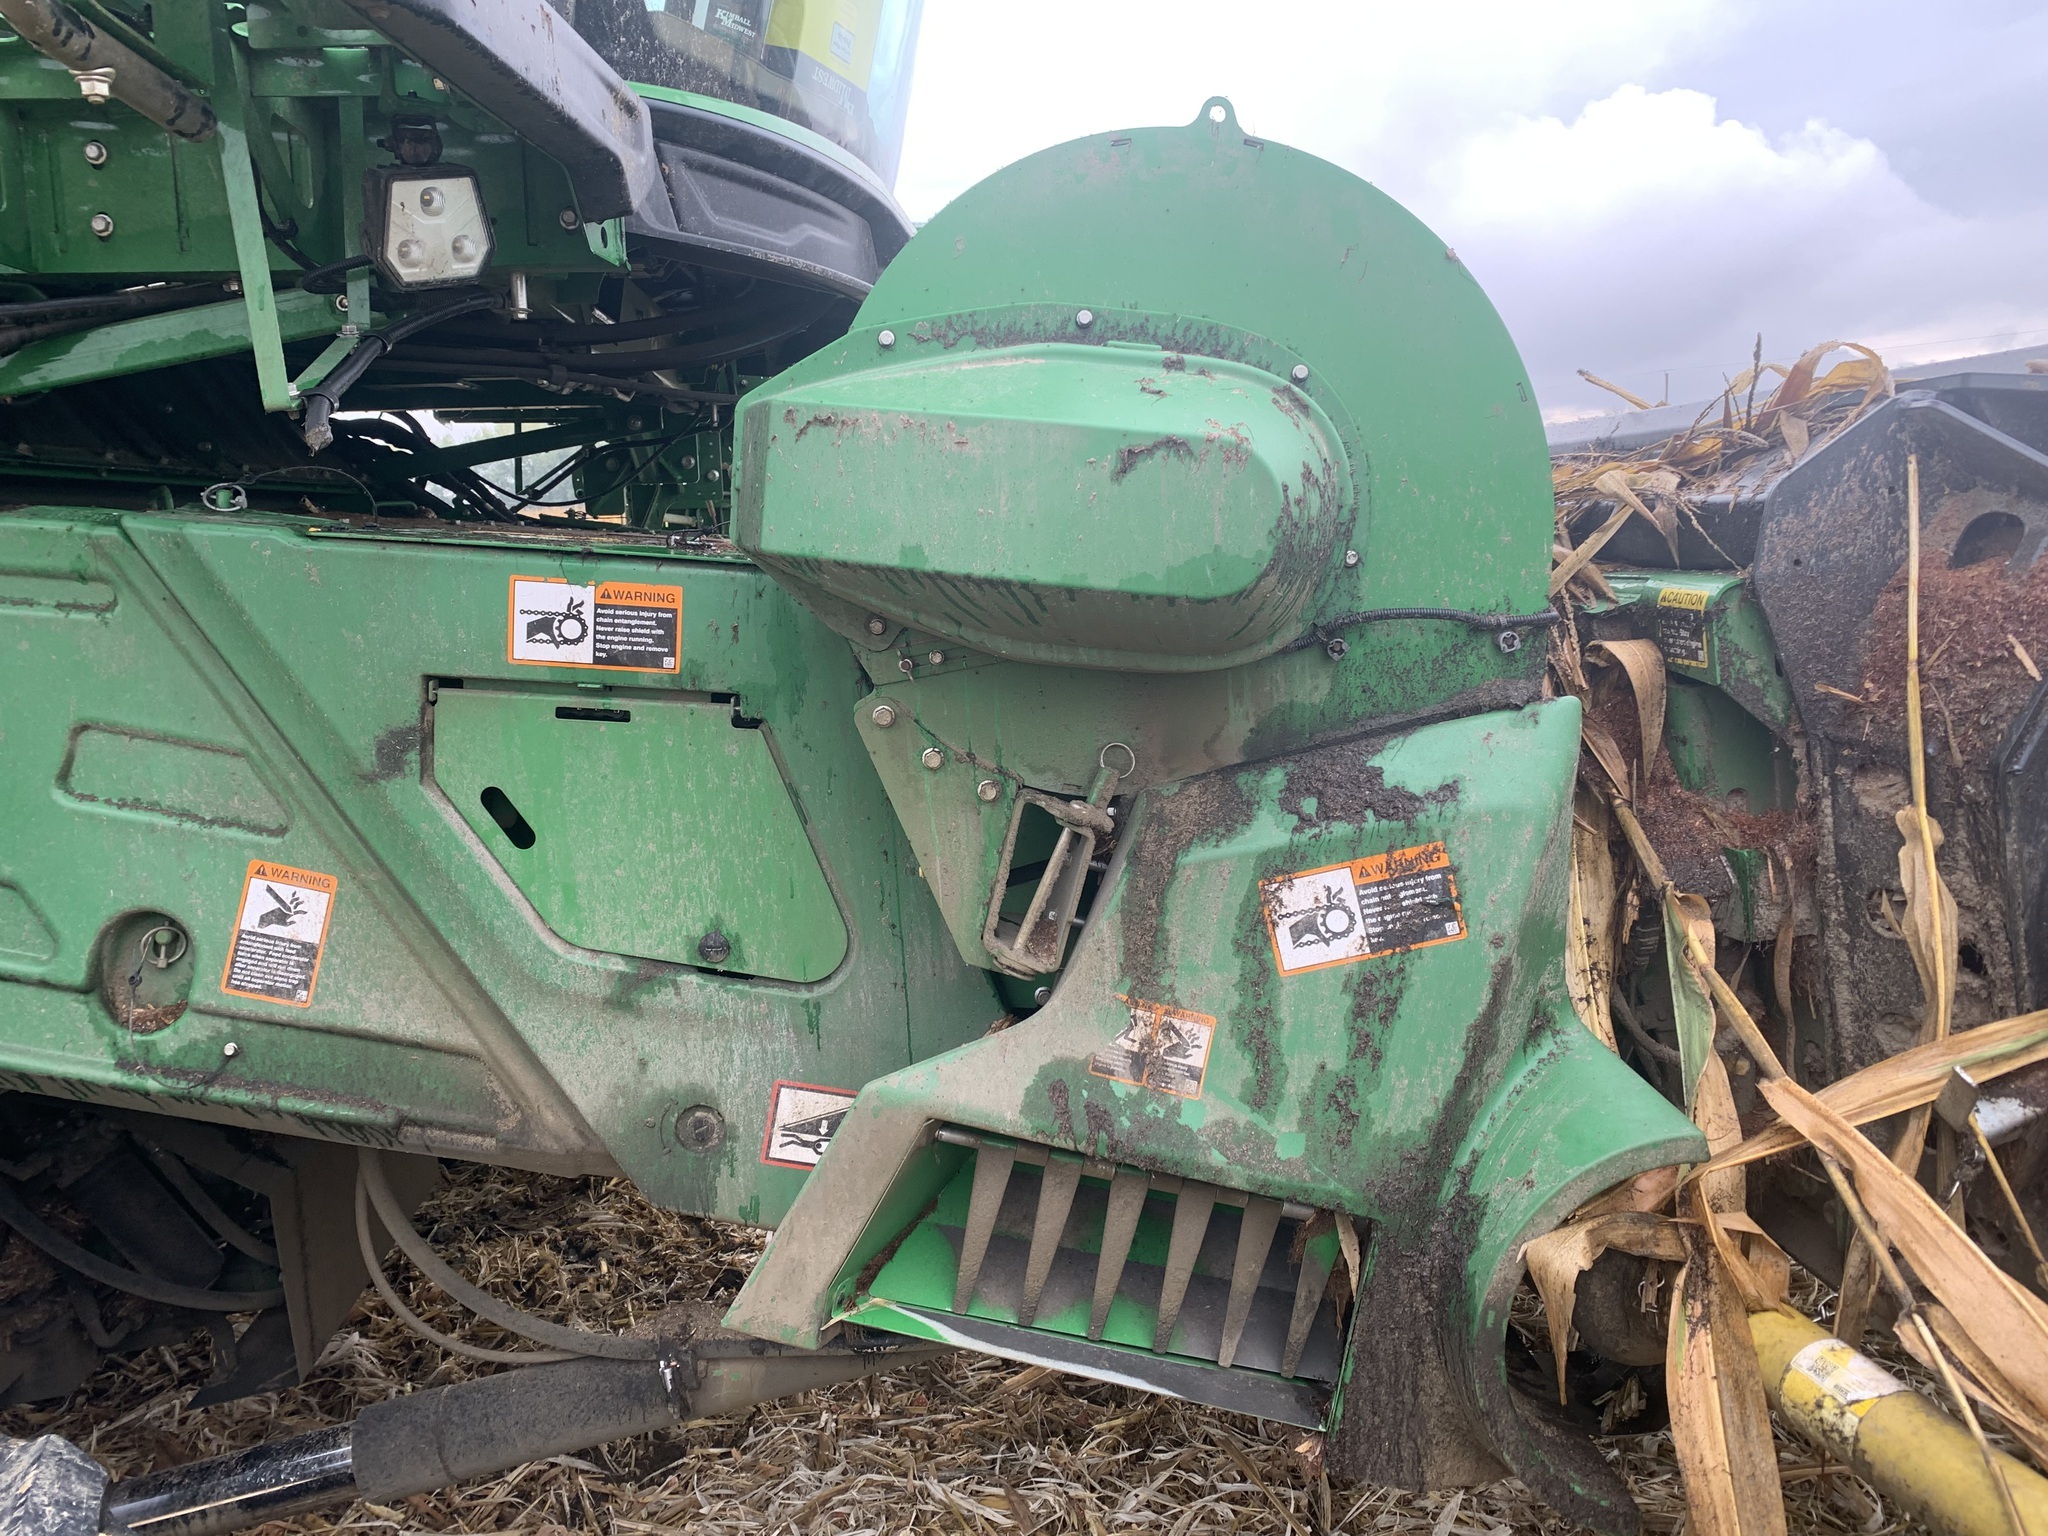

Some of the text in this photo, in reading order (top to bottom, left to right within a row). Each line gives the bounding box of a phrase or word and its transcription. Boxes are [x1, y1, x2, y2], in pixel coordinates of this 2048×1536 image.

[714, 8, 751, 26] KIMBALL
[720, 17, 756, 38] MIDWEST
[613, 590, 676, 604] WARNING
[1668, 591, 1704, 606] CAUTION
[271, 868, 331, 888] WARNING
[1359, 886, 1378, 896] Avoid
[1425, 874, 1442, 882] from
[1360, 896, 1380, 906] chain
[1363, 906, 1382, 916] Never
